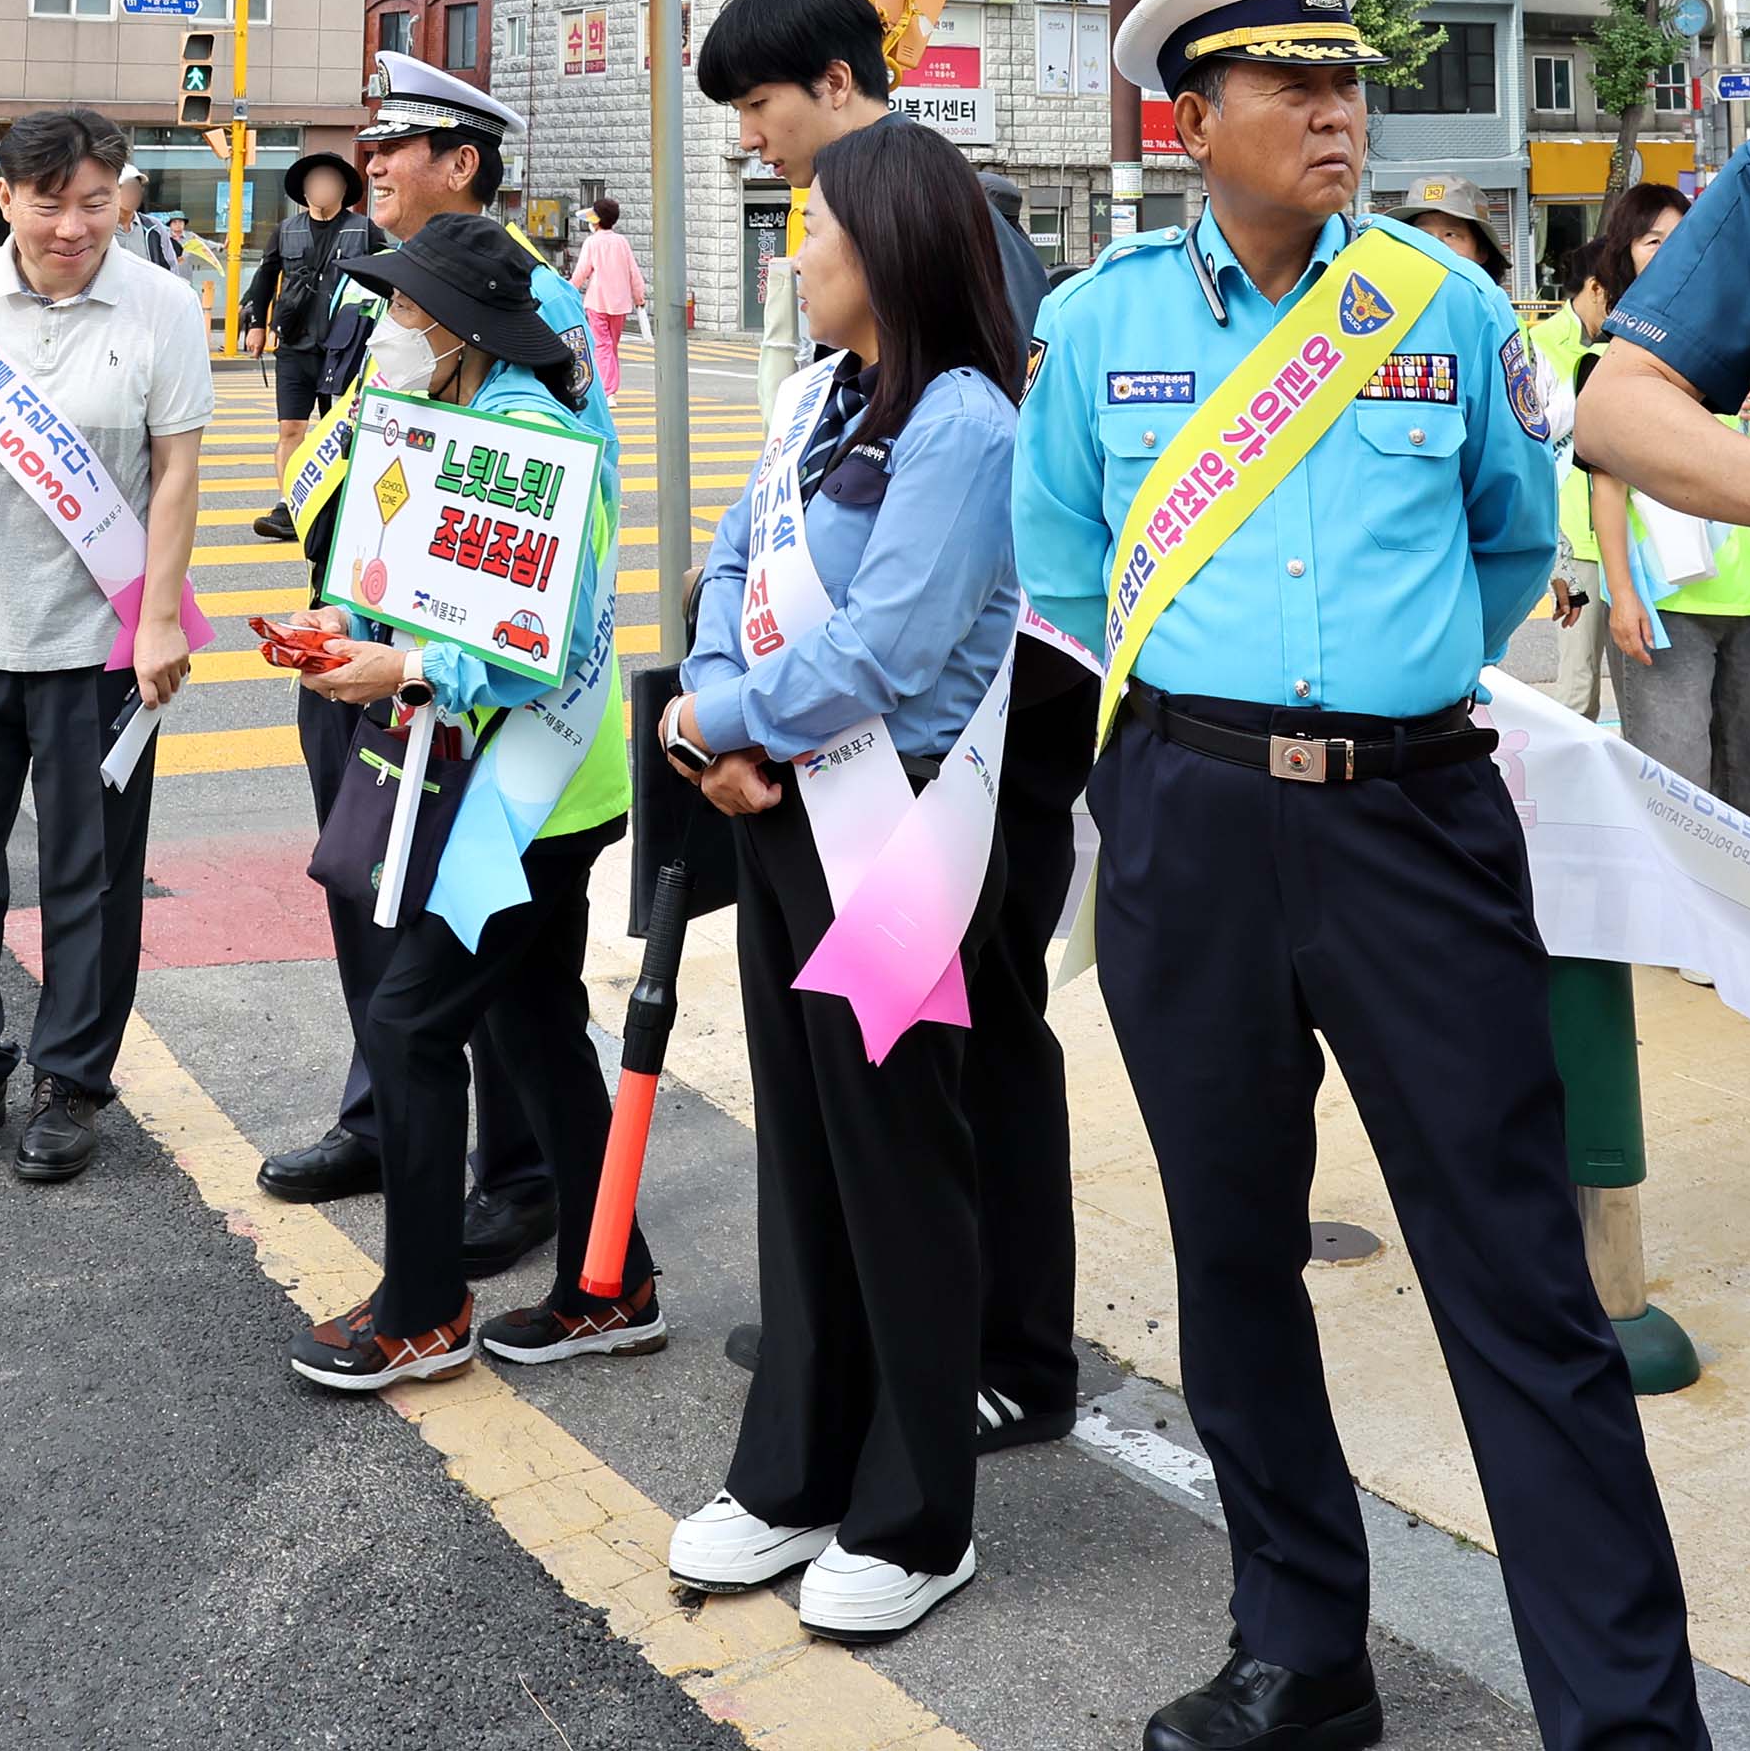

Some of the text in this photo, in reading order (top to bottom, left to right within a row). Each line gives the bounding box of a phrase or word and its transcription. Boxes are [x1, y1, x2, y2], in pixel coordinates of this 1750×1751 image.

[568, 20, 604, 57] 수학
[6, 384, 100, 493] 지킵시다!
[1222, 333, 1344, 465] 어린이가
[0, 428, 82, 522] 5030
[380, 478, 404, 496] SCHOOL
[381, 493, 398, 507] ZONE
[435, 439, 565, 521] 느릿느릿!
[773, 466, 797, 553] 시속
[1147, 453, 1238, 554] 안전한
[428, 505, 559, 593] 조심조심!
[752, 480, 771, 562] 이하
[429, 599, 469, 626] 제물포구
[748, 569, 785, 657] 서행
[1116, 540, 1156, 618] 인천
[542, 711, 584, 748] 제물포구
[828, 731, 876, 767] 제물포구
